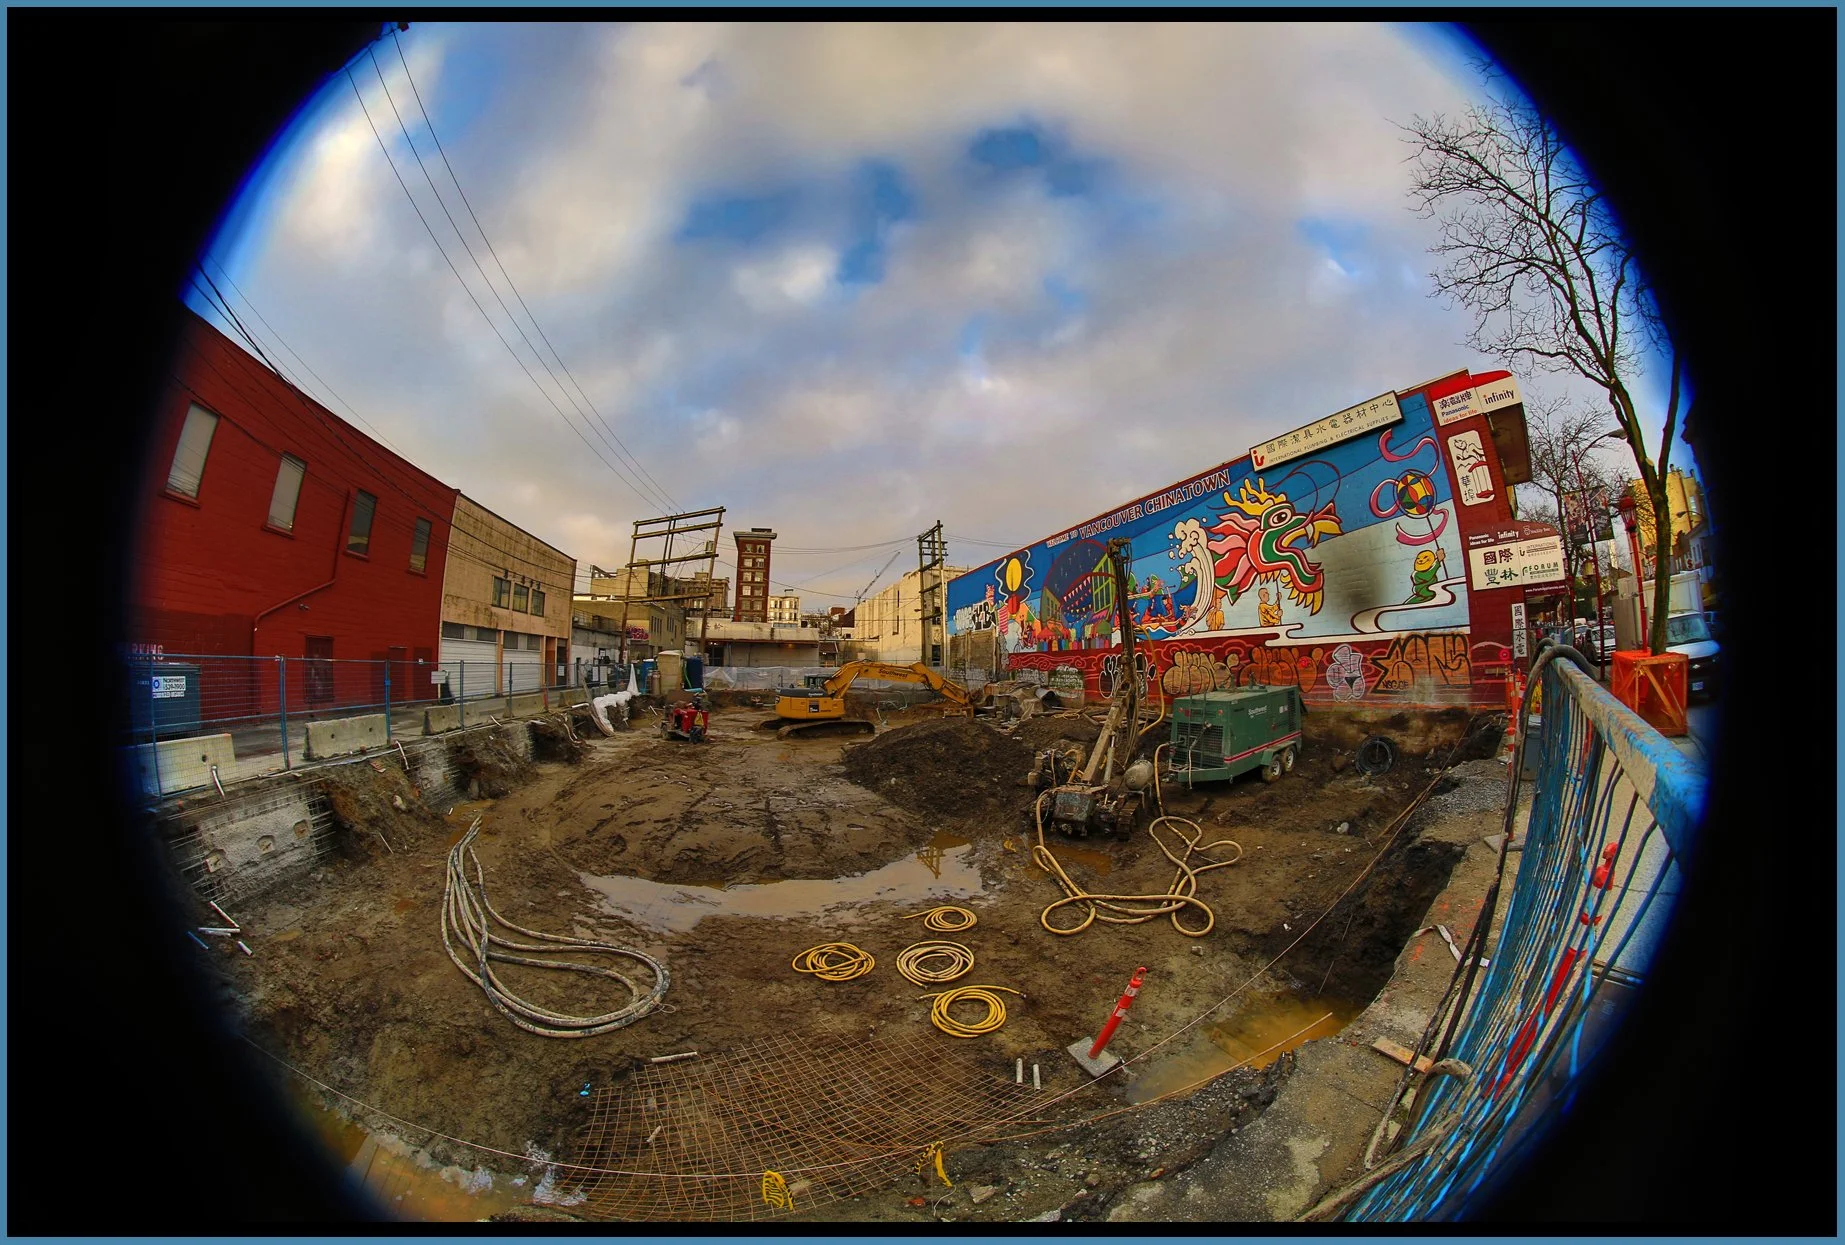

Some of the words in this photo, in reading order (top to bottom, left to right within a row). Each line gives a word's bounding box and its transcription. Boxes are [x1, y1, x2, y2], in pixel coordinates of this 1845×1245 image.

[1483, 389, 1514, 405] infinity
[1441, 404, 1470, 416] Panasonic
[1268, 448, 1302, 462] INTERNATIONAL
[1304, 438, 1328, 450] PLUMBING
[1336, 425, 1365, 438] ELECTRICAL
[1366, 416, 1388, 428] SUPPLIES
[1079, 505, 1144, 540] VANCOUVER
[1144, 468, 1231, 515] CHINATOWN
[1483, 548, 1514, 566] 國際
[1528, 562, 1558, 571] FORUM
[878, 668, 909, 678] Southwest
